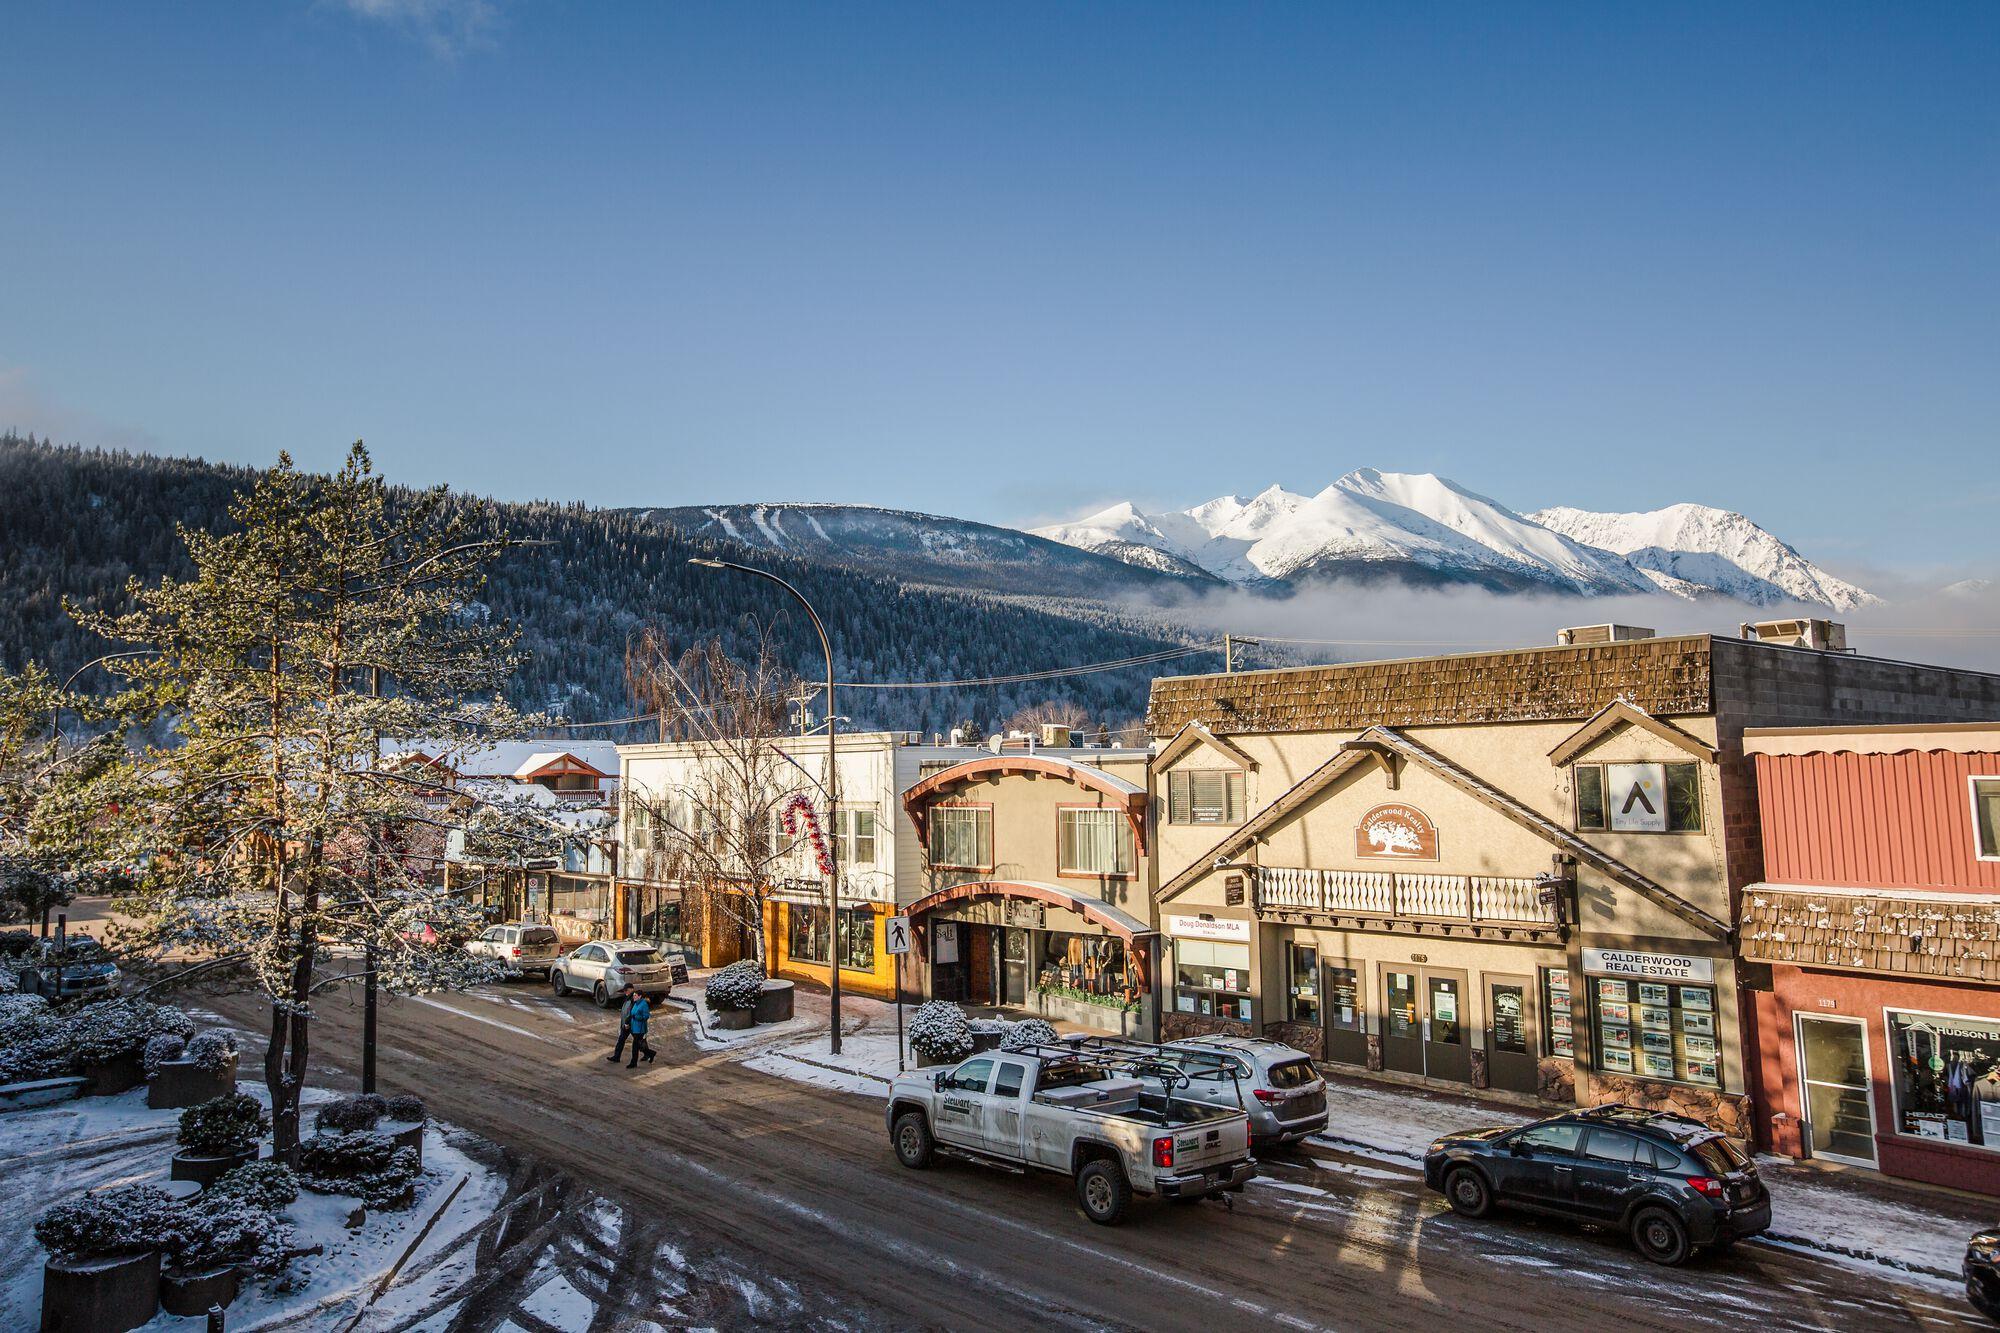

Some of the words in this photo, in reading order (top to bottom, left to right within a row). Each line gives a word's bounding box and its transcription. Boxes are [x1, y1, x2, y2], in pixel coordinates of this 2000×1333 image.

[1363, 808, 1402, 832] Calderwood
[1404, 810, 1425, 834] Realty
[1640, 818, 1661, 827] Supply
[1179, 919, 1194, 929] Doug
[1195, 920, 1226, 930] Donaldson
[1226, 923, 1240, 931] MLA
[1601, 952, 1692, 968] CALDERWOOD
[1605, 962, 1638, 973] REAL
[1641, 965, 1689, 978] ESTATE
[1818, 999, 1835, 1008] 1179
[1936, 1026, 1987, 1040] HUDSON
[1989, 1031, 2000, 1041] B
[943, 1093, 970, 1109] Stewart
[1905, 1111, 1948, 1119] HEAD
[1176, 1136, 1199, 1148] Stewart
[1204, 1140, 1221, 1150] GMC
